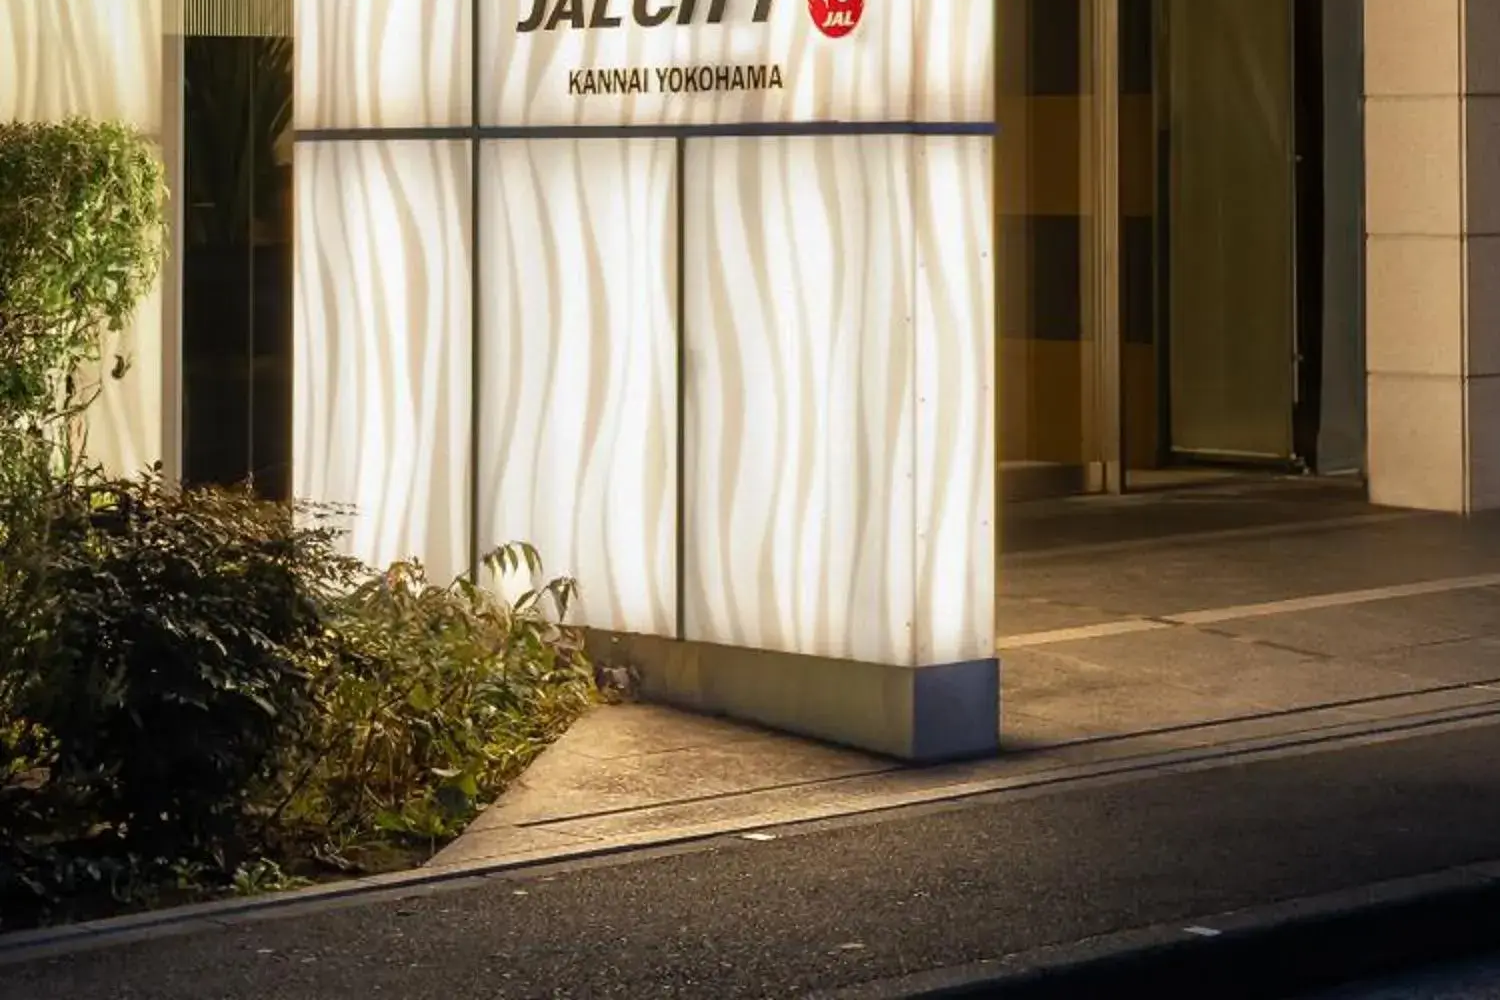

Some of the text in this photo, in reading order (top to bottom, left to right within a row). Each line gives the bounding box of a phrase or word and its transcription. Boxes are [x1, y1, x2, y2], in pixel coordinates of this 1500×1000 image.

[821, 10, 855, 27] JAL
[569, 65, 783, 95] KANNAI YOKOHAMA
